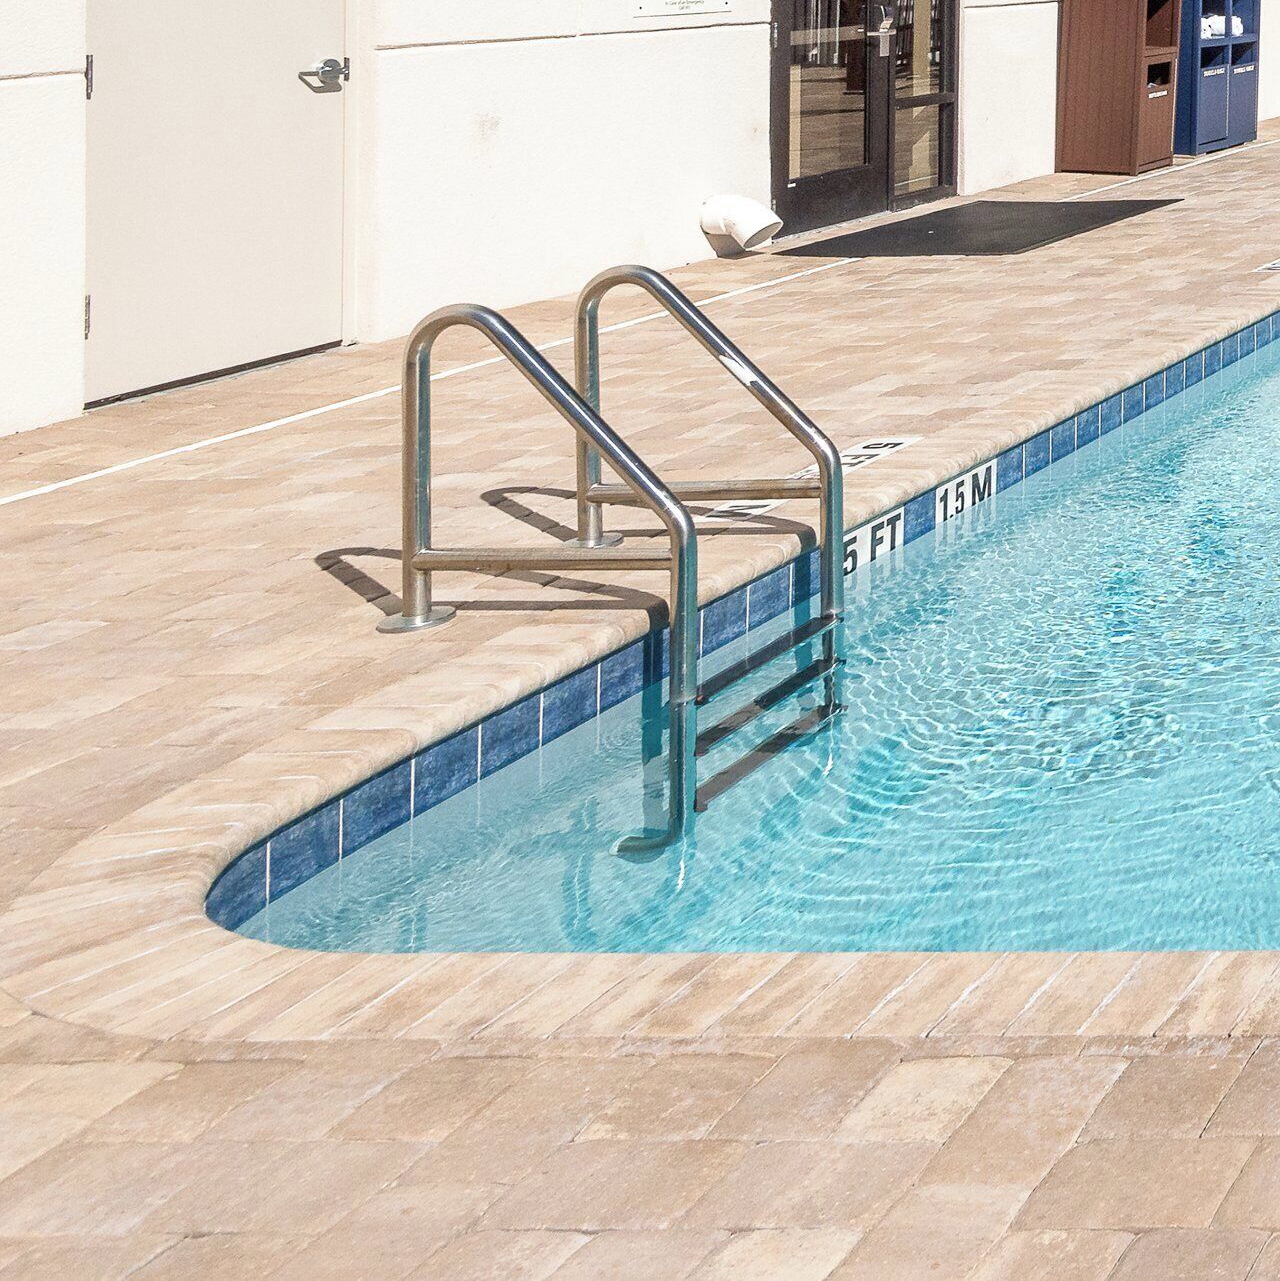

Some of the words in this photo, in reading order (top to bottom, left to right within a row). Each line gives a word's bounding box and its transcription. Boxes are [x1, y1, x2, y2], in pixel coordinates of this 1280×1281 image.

[939, 479, 965, 522] 1.5
[972, 465, 992, 506] M
[843, 535, 858, 576] 5
[870, 513, 901, 562] FT
